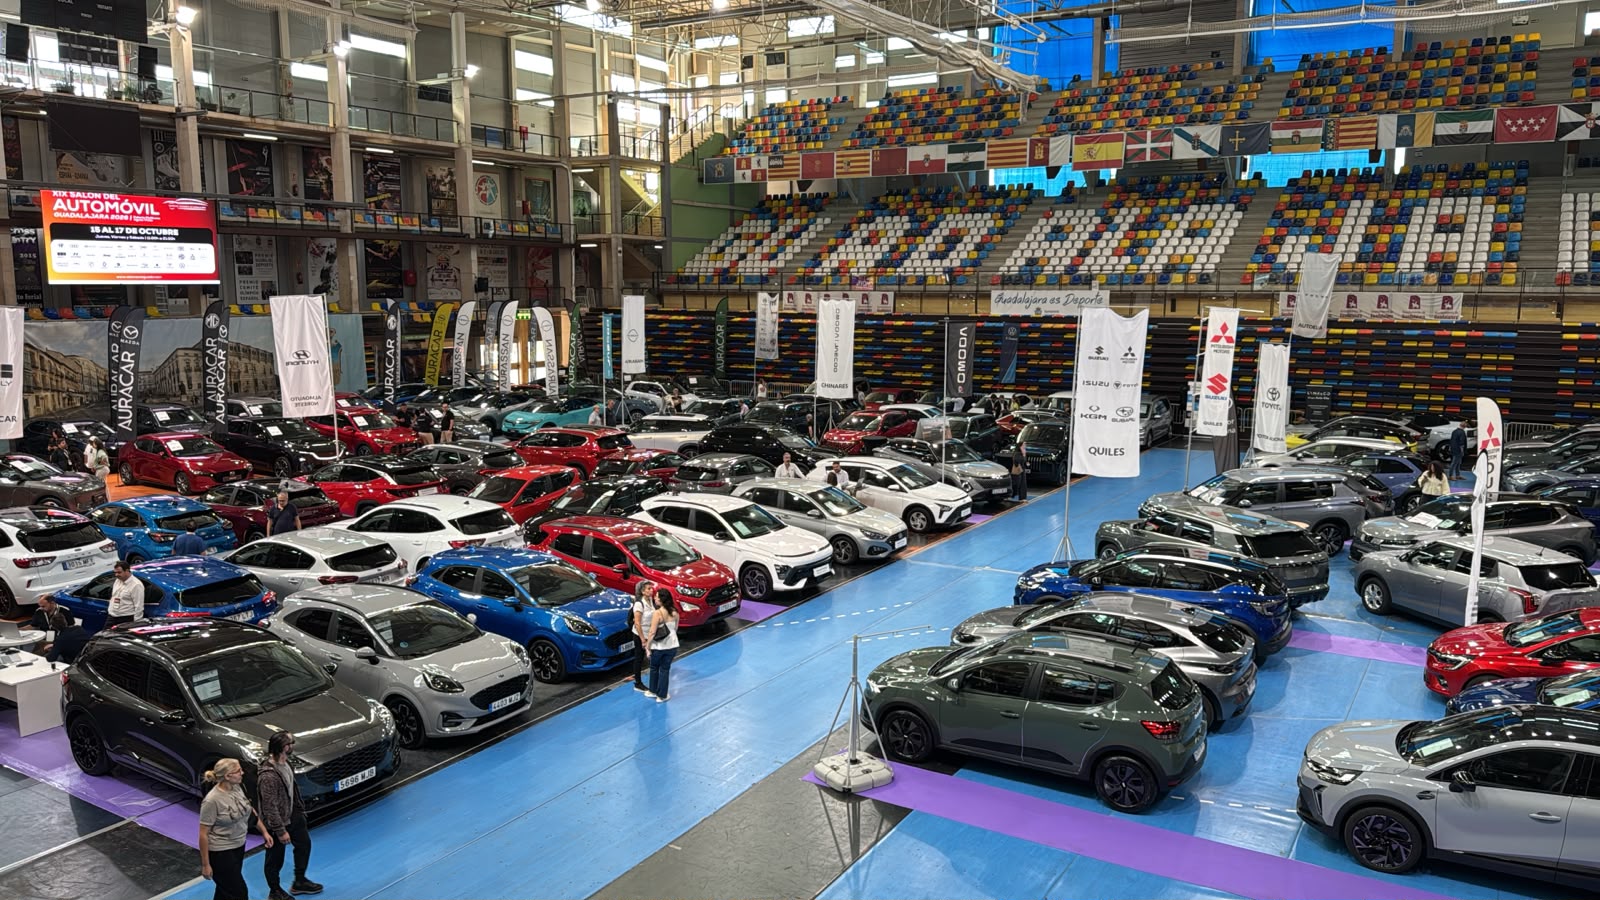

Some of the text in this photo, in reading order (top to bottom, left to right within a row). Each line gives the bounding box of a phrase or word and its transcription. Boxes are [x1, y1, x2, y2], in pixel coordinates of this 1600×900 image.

[53, 198, 160, 216] AUTOMÓVIL
[70, 191, 101, 199] SALON
[995, 292, 1103, 309] Guadalajara es Deporte
[206, 337, 217, 401] AURACAR
[384, 339, 395, 405] AURACAR
[427, 329, 442, 382] AURACAR
[500, 333, 509, 389] AURASSAN
[568, 332, 577, 388] AURACAR
[716, 324, 726, 372] AURACAR
[118, 351, 135, 431] AURACAR
[216, 349, 226, 424] AURACAR
[1088, 446, 1125, 456] QUILES
[493, 699, 507, 710] 4403
[340, 769, 374, 789] 5696 MJB
